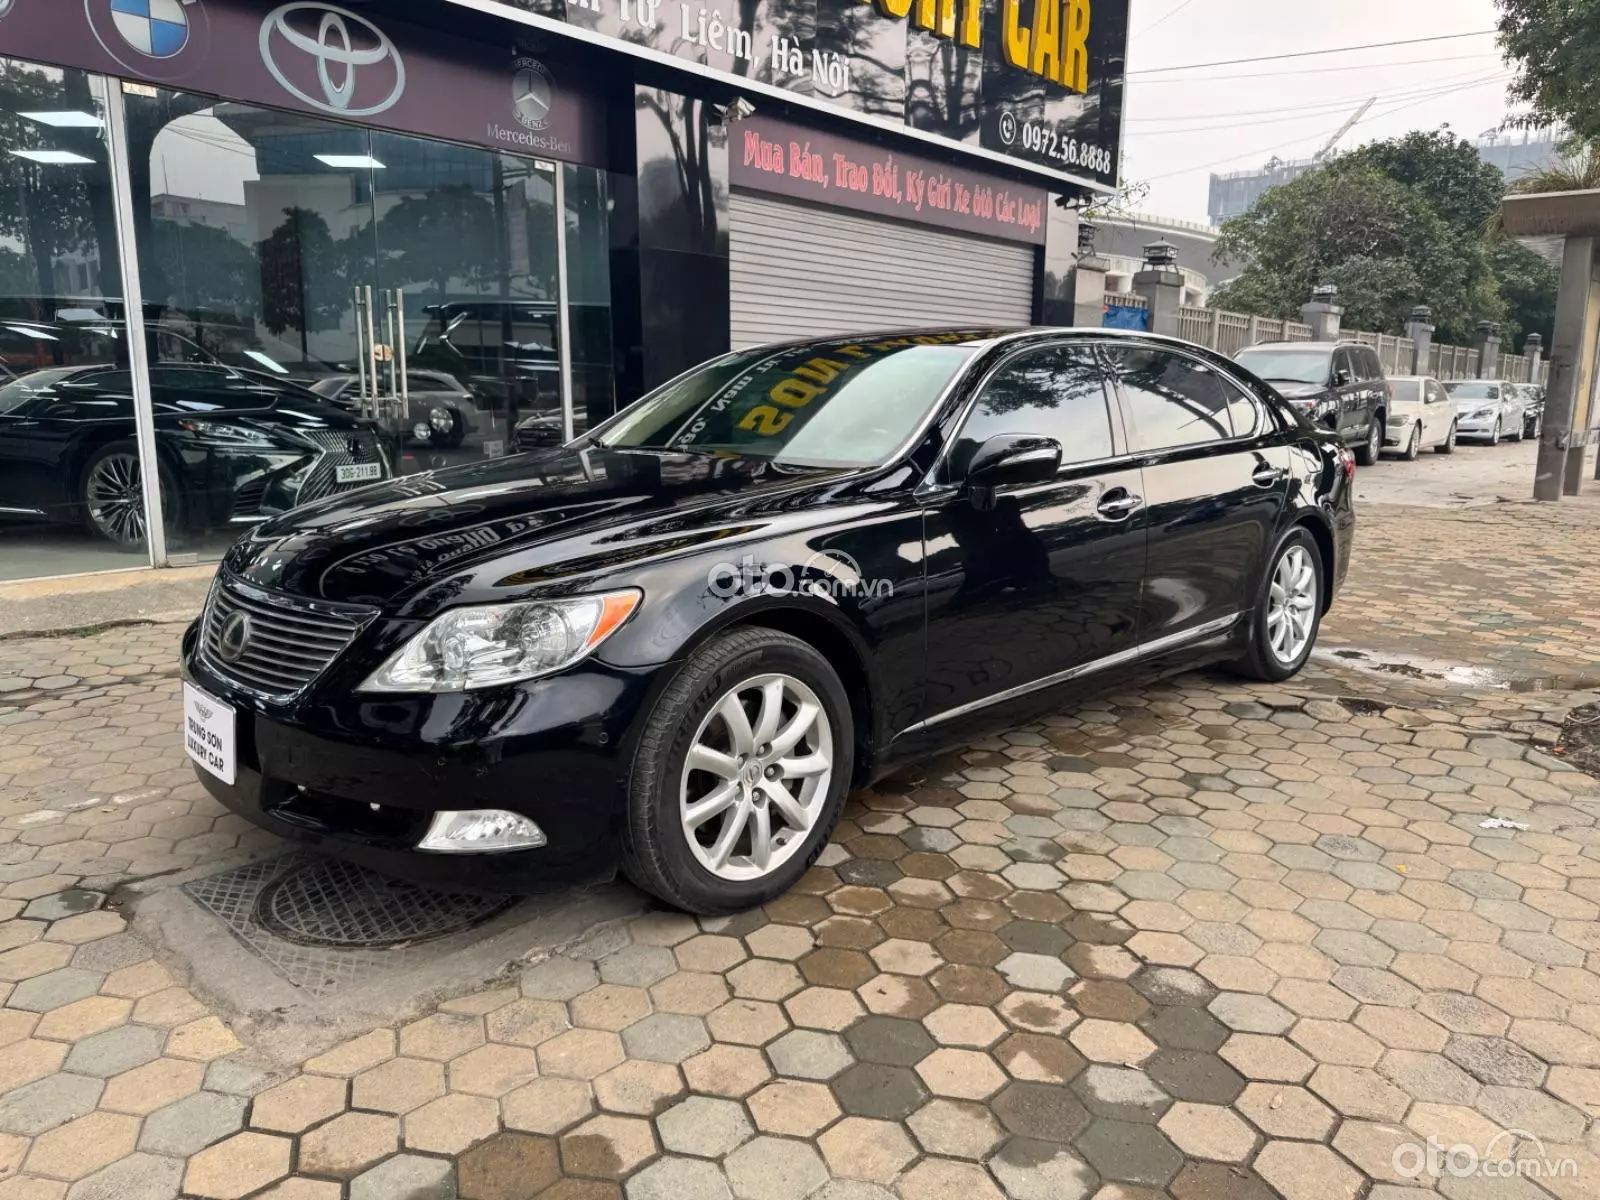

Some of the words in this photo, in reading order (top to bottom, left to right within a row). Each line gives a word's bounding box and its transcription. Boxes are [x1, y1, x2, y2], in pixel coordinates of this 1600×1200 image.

[680, 4, 760, 70] Liêm,
[771, 35, 804, 76] Hà
[812, 49, 851, 97] Nội
[1003, 0, 1091, 94] CAR
[744, 130, 785, 174] Mua
[789, 141, 829, 188] Bán,
[832, 153, 868, 193] Trao
[872, 154, 902, 204] Đổi,
[906, 169, 925, 212] Ký
[927, 174, 952, 210] Gửi
[953, 183, 970, 214] Xe
[995, 191, 1016, 224] Các
[1018, 196, 1041, 234] Loại
[1021, 123, 1111, 174] 0972.56.8888
[208, 751, 224, 773] CAR
